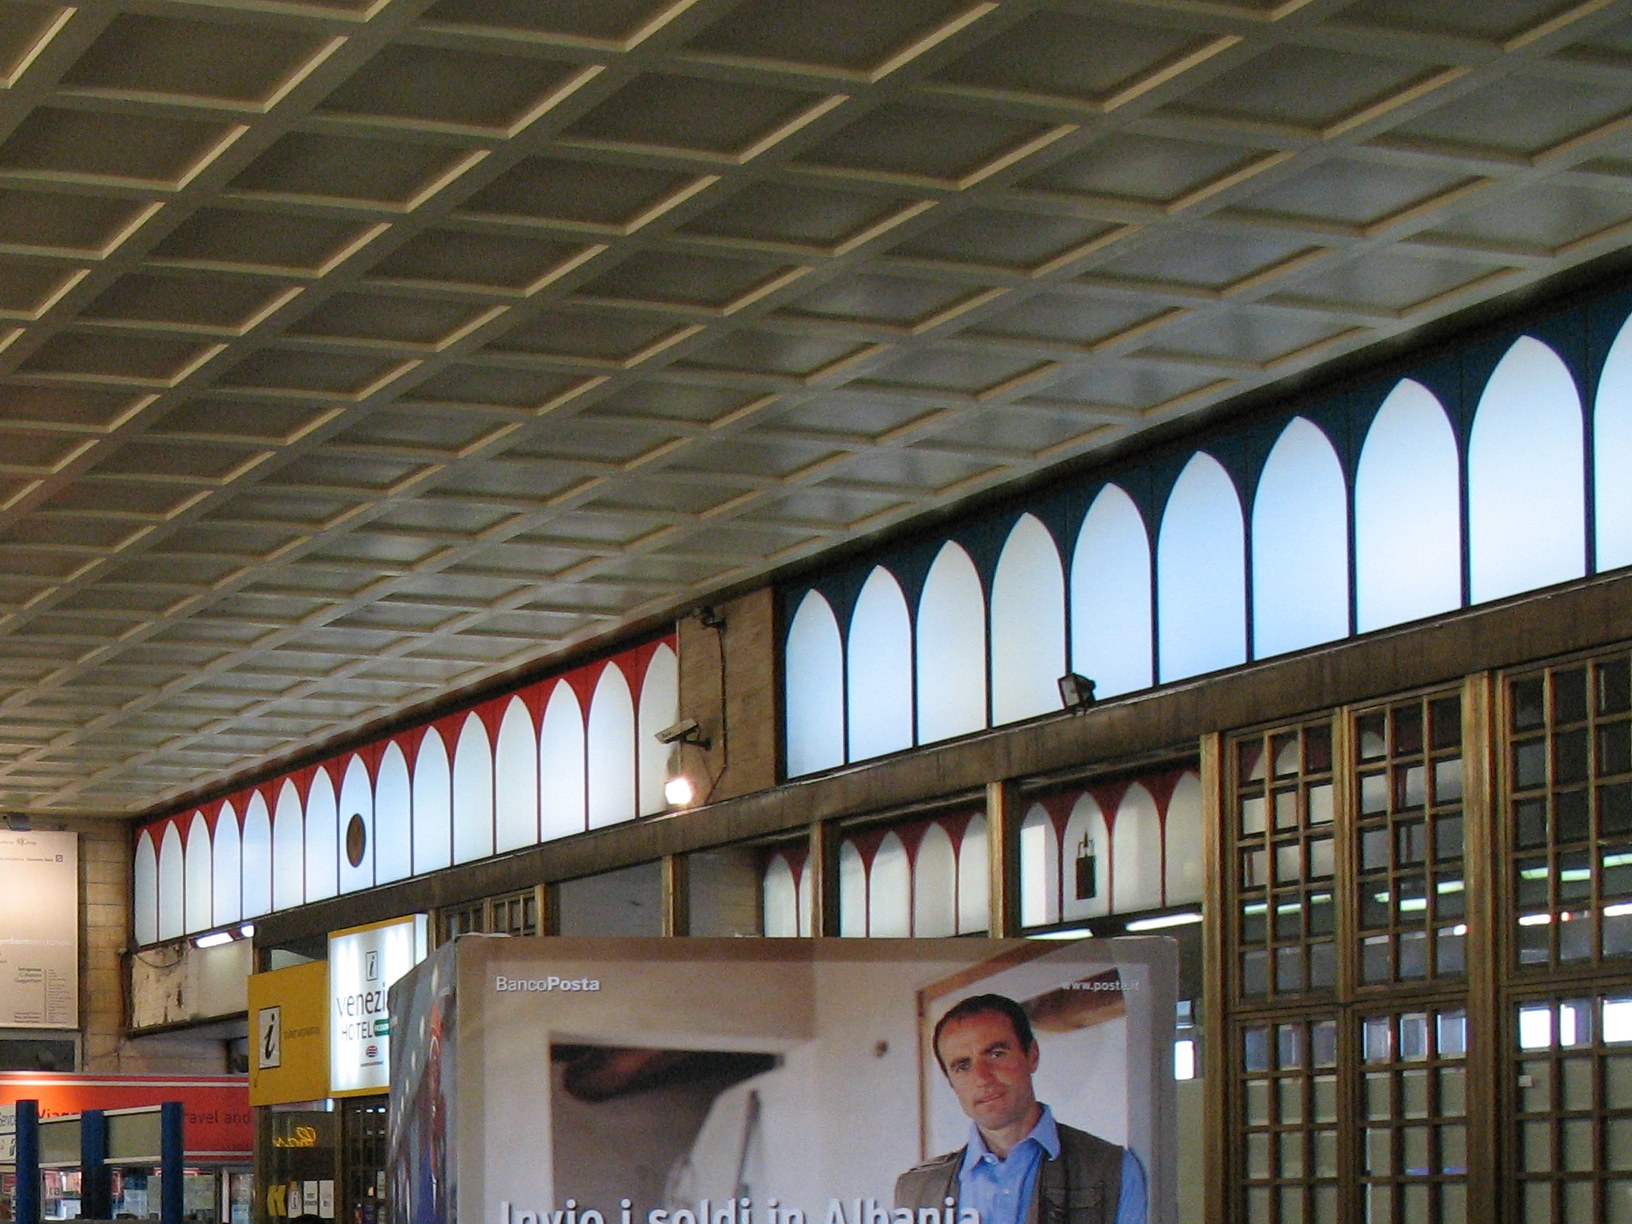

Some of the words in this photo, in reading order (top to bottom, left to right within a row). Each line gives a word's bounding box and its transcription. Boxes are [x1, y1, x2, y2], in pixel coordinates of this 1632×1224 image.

[495, 975, 601, 992] BancoPosta
[1061, 980, 1141, 993] www.poste.it
[336, 982, 388, 1017] venezi
[341, 1021, 374, 1042] HOTEL
[183, 1110, 218, 1125] ravel
